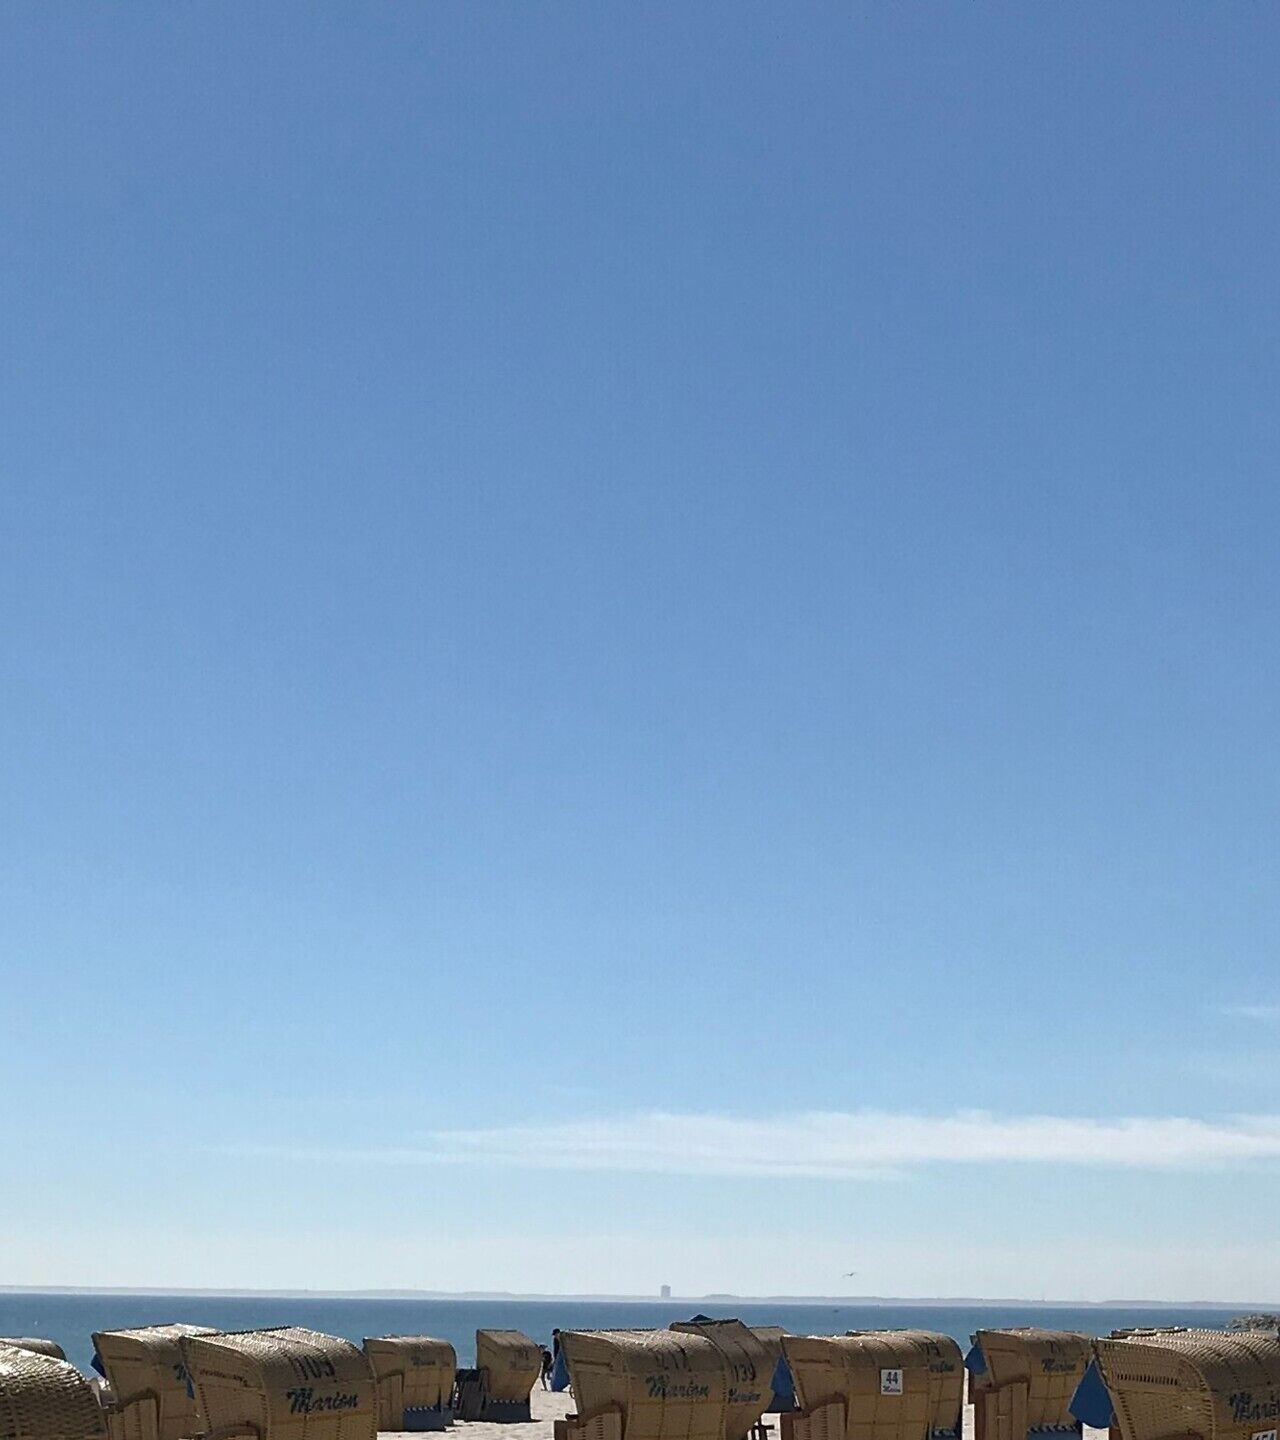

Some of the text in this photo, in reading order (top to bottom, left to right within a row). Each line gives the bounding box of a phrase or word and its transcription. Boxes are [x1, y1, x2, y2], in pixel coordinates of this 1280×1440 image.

[645, 1375, 708, 1400] Marion
[886, 1371, 899, 1385] 44
[286, 1387, 359, 1413] Marion
